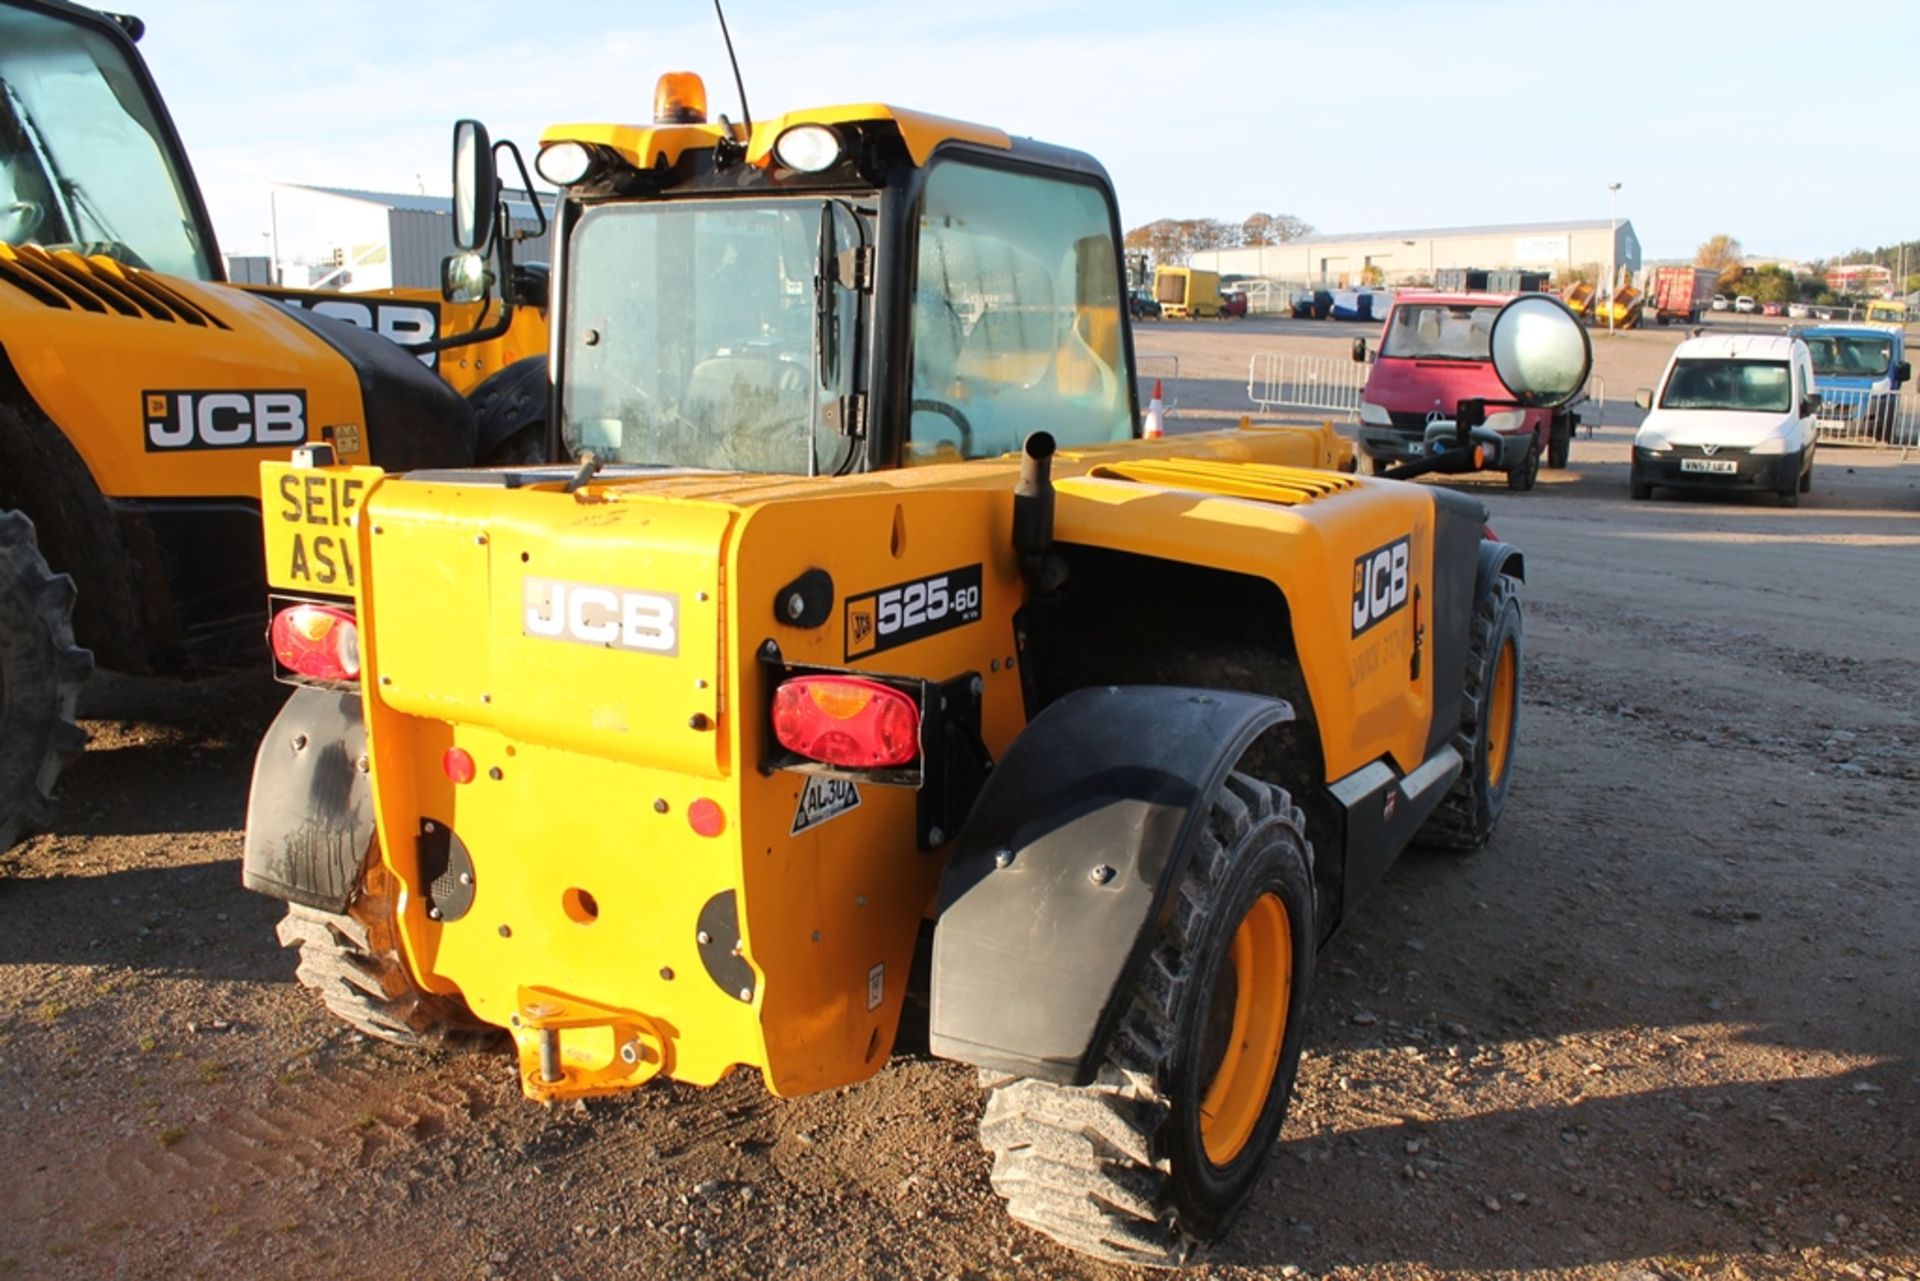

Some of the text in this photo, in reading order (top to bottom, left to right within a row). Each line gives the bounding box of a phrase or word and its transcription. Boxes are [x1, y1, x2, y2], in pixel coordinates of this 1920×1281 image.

[148, 393, 305, 447] JCB
[526, 583, 676, 651] JCB
[1353, 541, 1409, 630] JCB
